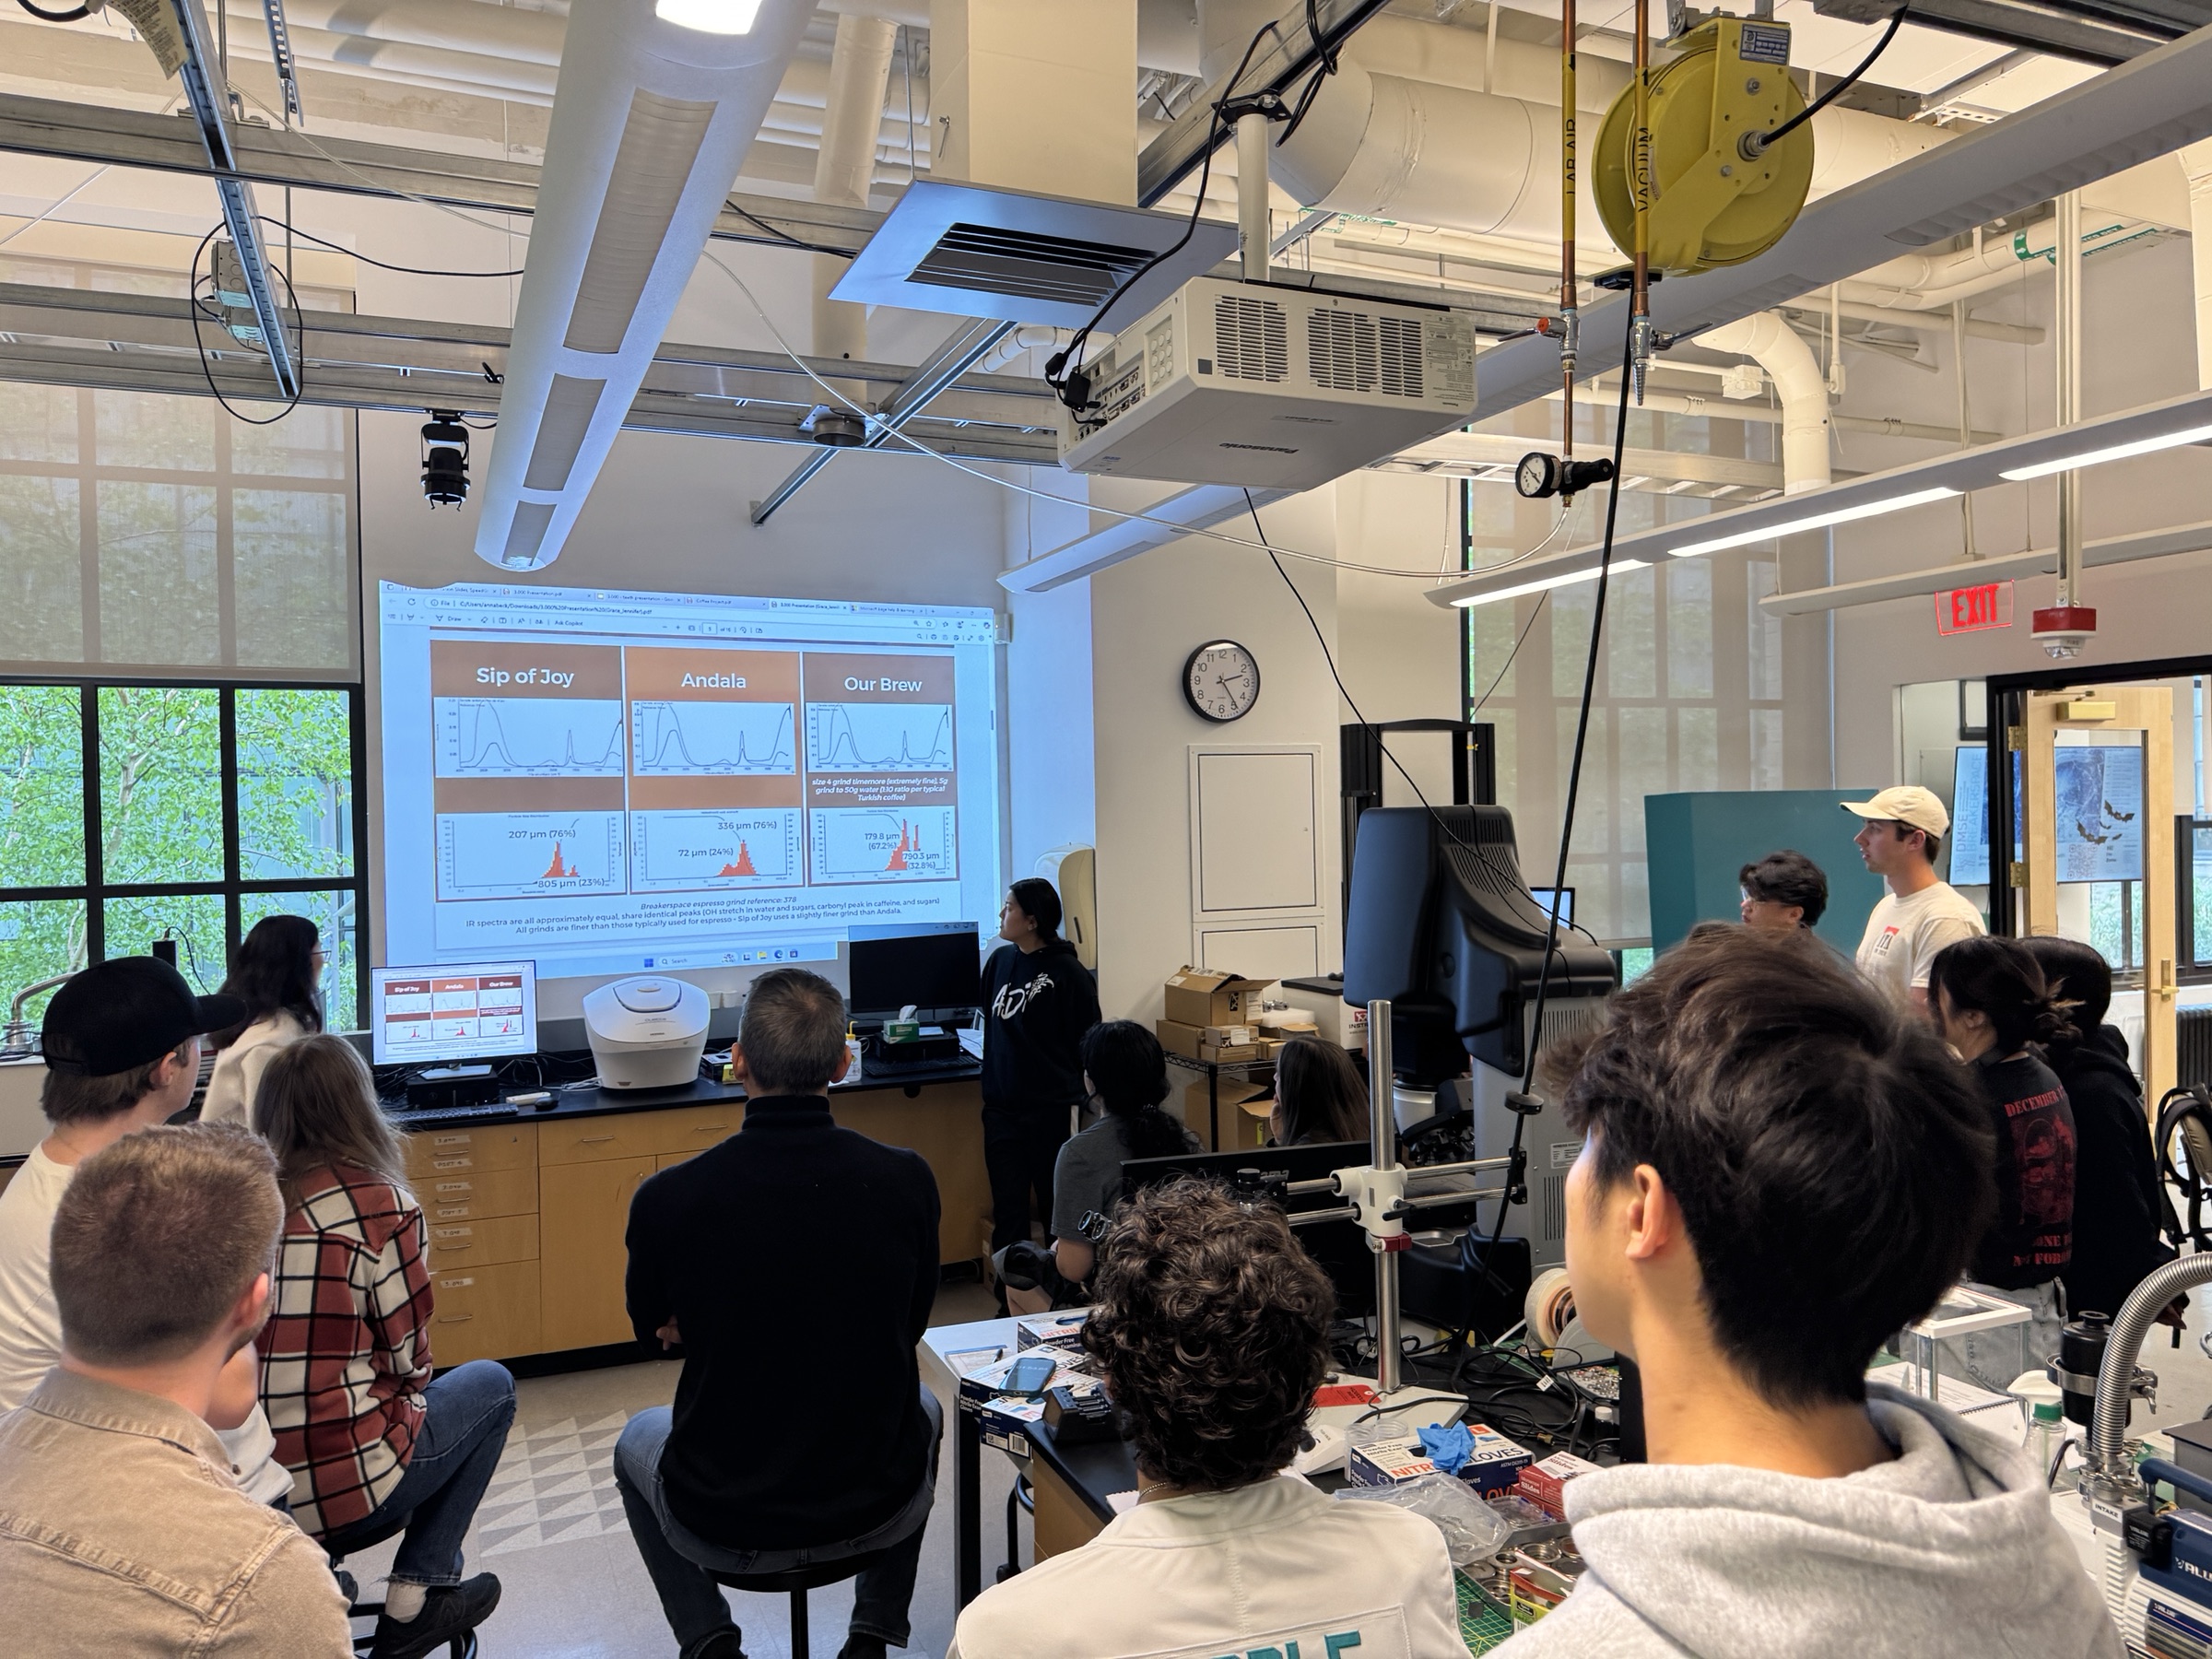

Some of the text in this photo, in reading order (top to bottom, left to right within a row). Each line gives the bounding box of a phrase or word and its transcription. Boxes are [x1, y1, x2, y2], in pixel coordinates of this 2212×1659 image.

[1218, 442, 1300, 454] Panasonic
[1951, 583, 1999, 628] EXIT
[1206, 653, 1215, 663] 11
[1218, 649, 1228, 659] 12
[1232, 653, 1236, 663] 1
[1197, 662, 1207, 673] 10
[1241, 664, 1247, 673] 2
[476, 666, 574, 688] Sip of Joy
[681, 672, 747, 688] Andala
[1194, 676, 1201, 685] 9
[843, 677, 923, 692] Our Brew
[1242, 677, 1250, 688] 3
[1197, 689, 1204, 700] 8
[1240, 691, 1246, 700] 4
[1207, 700, 1214, 710] 7
[1218, 704, 1225, 713] 6
[1230, 701, 1237, 711] 5
[832, 778, 852, 786] grind
[887, 778, 921, 786] (extremely
[815, 786, 835, 795] grind
[844, 786, 859, 794] 50g
[923, 785, 946, 794] typical
[858, 794, 906, 802] Turkish coffee)
[1968, 755, 1981, 853] BREAKERSPACE
[717, 821, 778, 831] 336 µm (76%)
[509, 830, 576, 840] 207 µm (76%)
[886, 833, 900, 841] µm
[1956, 815, 1968, 853] DMSE
[868, 842, 898, 851] (67.2%)
[677, 848, 734, 858] 72 µm (24%)
[925, 853, 940, 861] µm
[907, 862, 936, 870] (32.8%)
[537, 877, 606, 889] 805 µm (23%)
[641, 901, 691, 910] Breakerspace
[725, 899, 747, 907] grind
[477, 919, 508, 928] spectra
[535, 914, 594, 925] approximately
[644, 911, 677, 919] identical
[678, 910, 701, 918] peaks
[848, 901, 865, 910] peak
[916, 898, 940, 906] sugars)
[528, 925, 555, 935] grinds
[634, 919, 667, 929] typically
[667, 918, 687, 926] used
[700, 917, 732, 925] espresso
[737, 915, 750, 924] Sip
[759, 914, 772, 923] Joy
[796, 912, 822, 921] slightly
[840, 910, 859, 918] grind
[2005, 1090, 2058, 1118] DECEMBER
[1521, 1481, 1540, 1495] Slides
[2094, 1503, 2119, 1519] INTAKE
